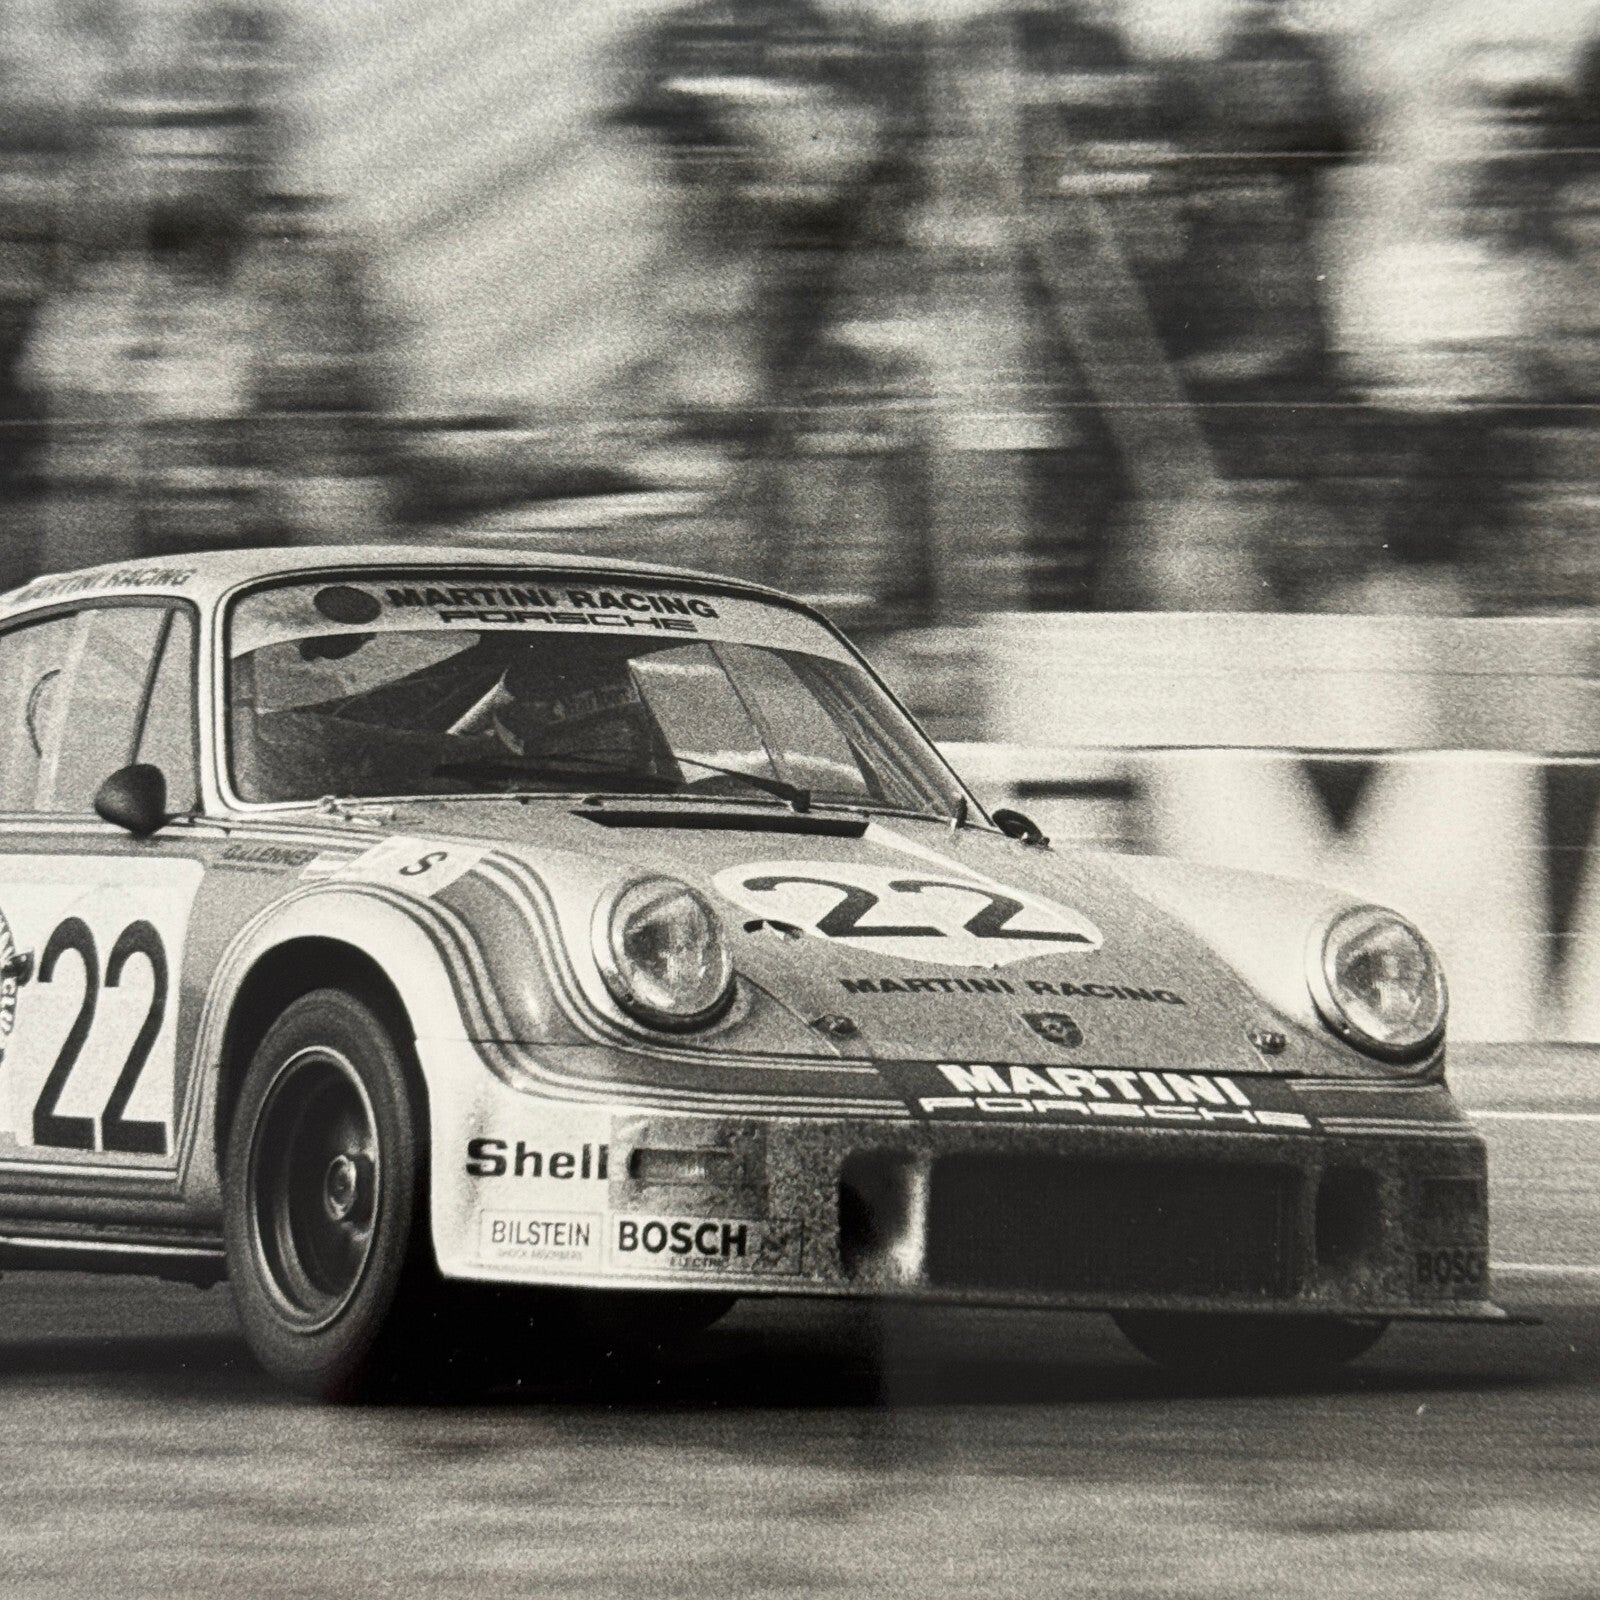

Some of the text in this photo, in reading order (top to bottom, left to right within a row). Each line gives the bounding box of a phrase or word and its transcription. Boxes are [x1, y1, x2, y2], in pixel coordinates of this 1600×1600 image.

[11, 568, 197, 604] ARTINI RACING
[386, 588, 719, 618] MARTINI RACING
[439, 610, 698, 632] PORSCHE
[742, 875, 1087, 945] 22
[840, 977, 1187, 1006] MARTINI RACING
[33, 916, 169, 1154] 22
[937, 1063, 1251, 1106] MARTINI
[918, 1097, 1312, 1130] PORSCHE
[465, 1137, 609, 1180] Shell
[491, 1220, 590, 1246] BILSTEIN
[618, 1220, 747, 1257] BOSCH
